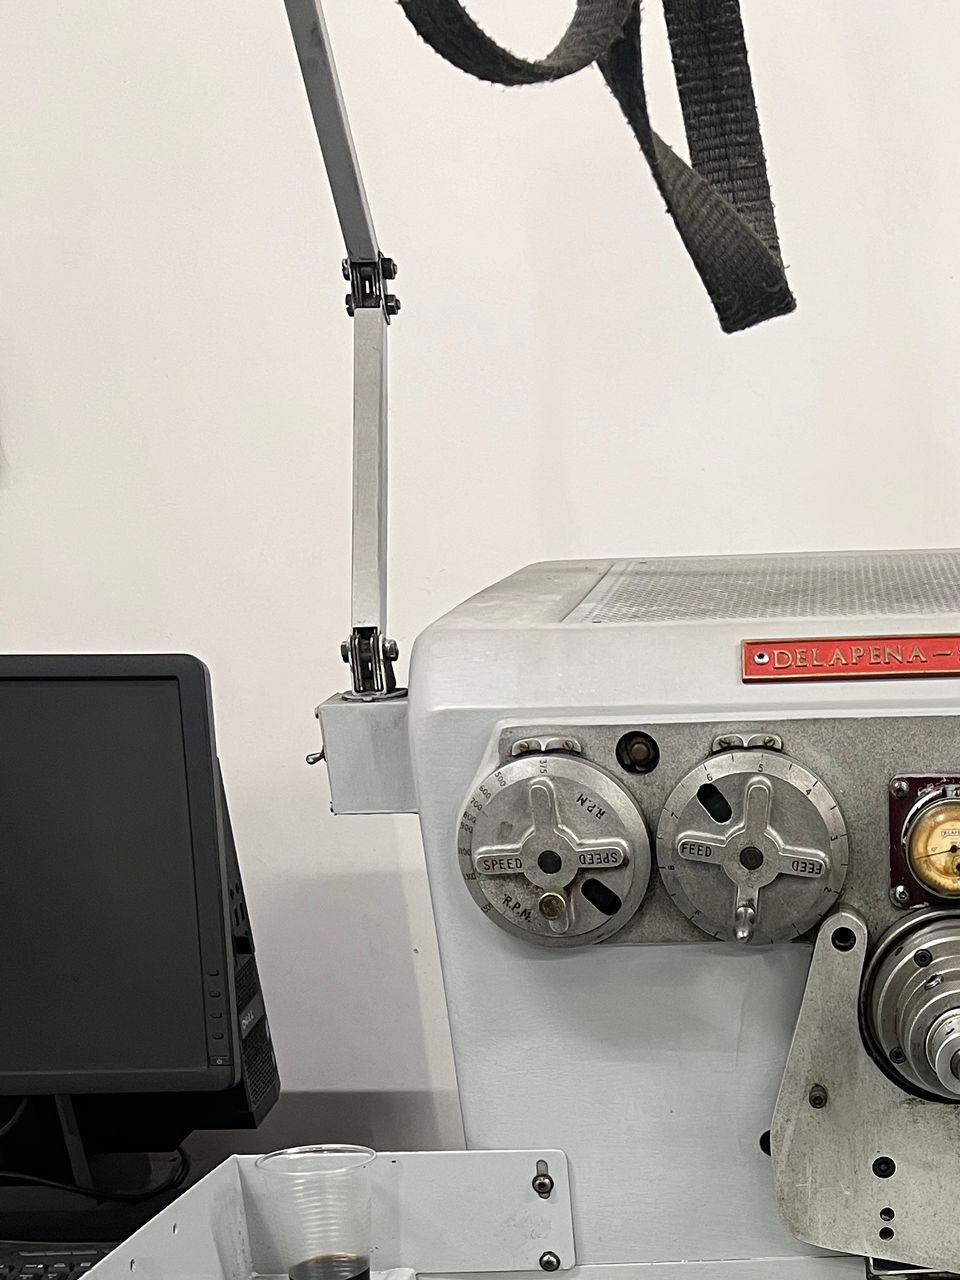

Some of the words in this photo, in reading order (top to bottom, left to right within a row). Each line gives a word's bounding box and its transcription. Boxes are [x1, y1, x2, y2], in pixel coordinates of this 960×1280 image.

[772, 644, 928, 669] DELAPENA
[539, 759, 548, 775] 375
[494, 771, 507, 787] 500
[479, 785, 492, 800] 600
[470, 797, 483, 812] 700
[681, 843, 713, 858] FEED
[483, 858, 523, 871] SPEED
[579, 852, 619, 865] SPEED
[791, 860, 823, 875] FEED
